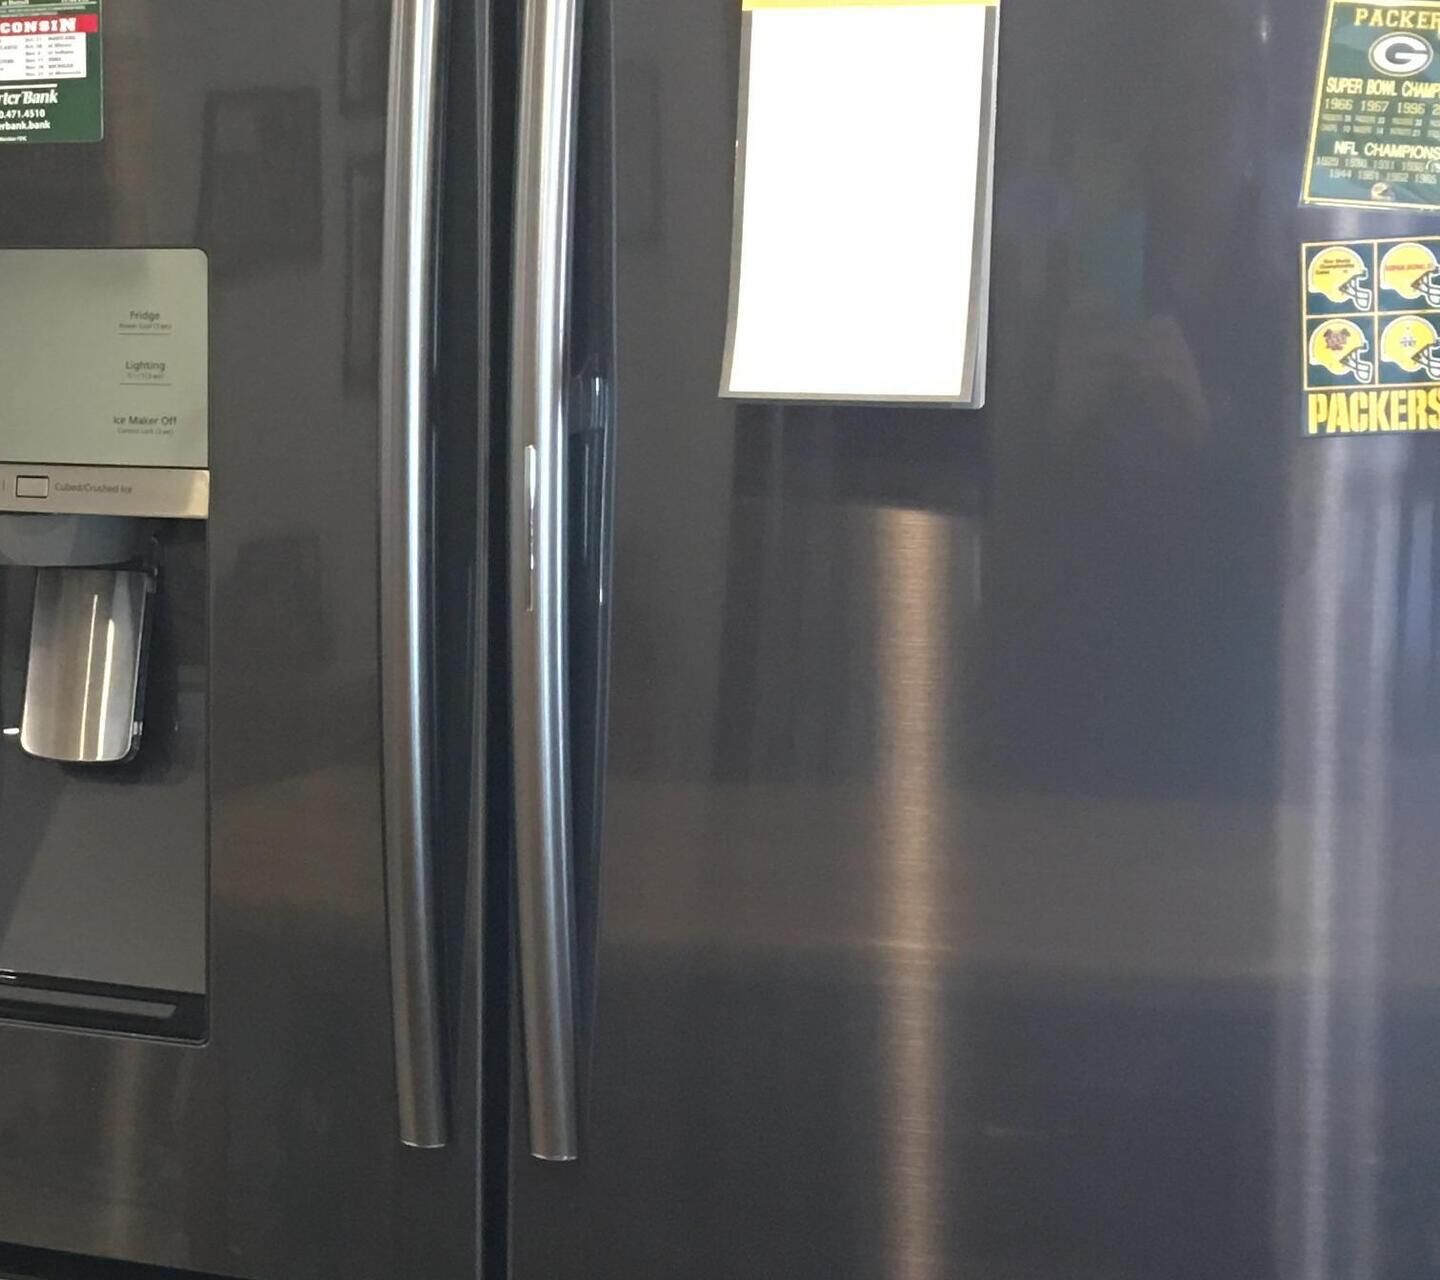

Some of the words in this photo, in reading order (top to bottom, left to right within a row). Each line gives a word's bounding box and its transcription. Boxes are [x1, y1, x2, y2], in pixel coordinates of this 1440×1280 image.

[1353, 8, 1440, 30] PACKER
[1326, 77, 1363, 94] SUPER
[1366, 79, 1398, 96] BOWL
[1401, 80, 1440, 98] CHAMP
[21, 89, 58, 105] Bank
[1325, 98, 1354, 111] 1966
[1360, 100, 1389, 113] 1967
[1334, 141, 1359, 156] NFL
[130, 311, 160, 322] Fridge
[125, 360, 166, 372] Lighting
[1308, 389, 1440, 434] PACKERS
[113, 416, 126, 425] Ice
[128, 416, 158, 425] Maker
[161, 416, 177, 426] Off
